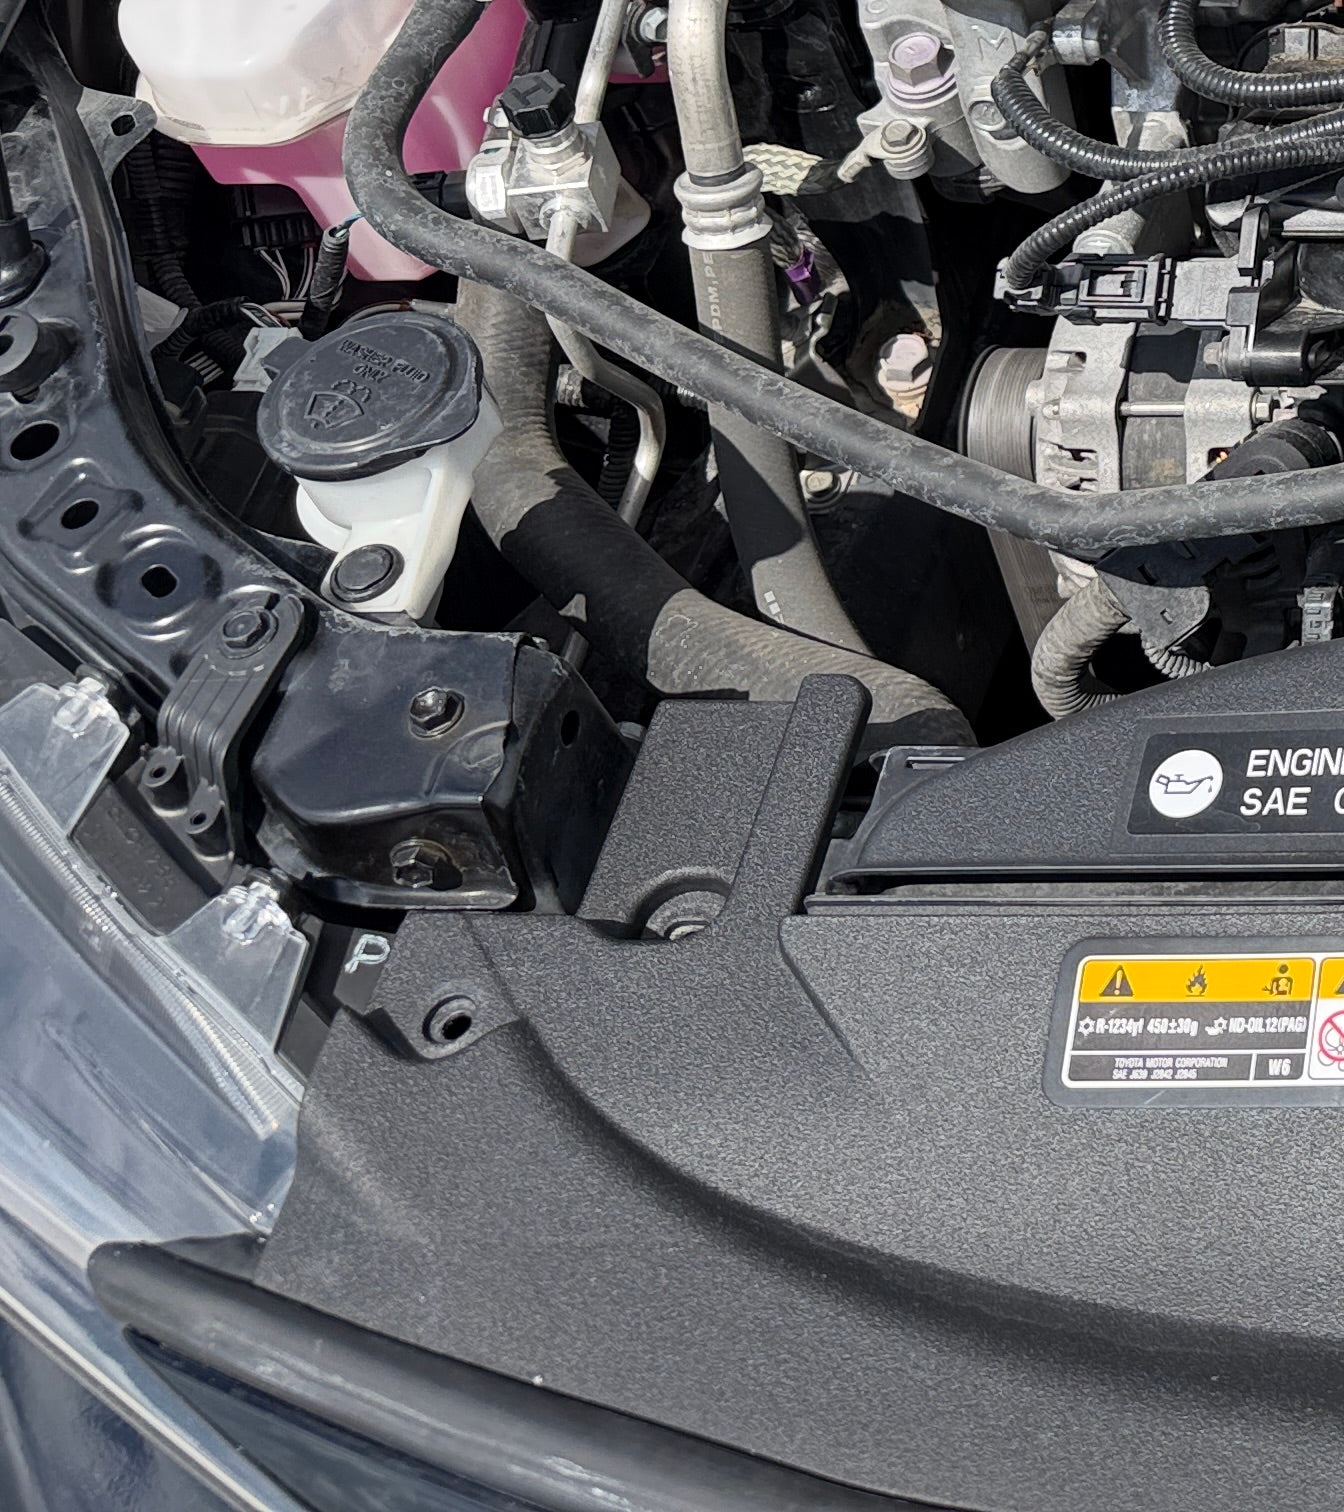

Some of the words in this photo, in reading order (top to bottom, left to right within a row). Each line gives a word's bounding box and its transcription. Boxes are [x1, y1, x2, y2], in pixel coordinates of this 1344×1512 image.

[338, 339, 393, 369] WASHER
[392, 359, 431, 384] FLUID
[352, 363, 390, 384] ONLY
[1239, 785, 1312, 817] SAE
[1095, 1017, 1145, 1037] R-1234yf
[1114, 1057, 1144, 1068] TOYOTA
[1145, 1057, 1174, 1068] MOTOR
[1174, 1056, 1229, 1068] CORPORATION
[1268, 1057, 1292, 1077] W6
[1112, 1068, 1128, 1080] SAE
